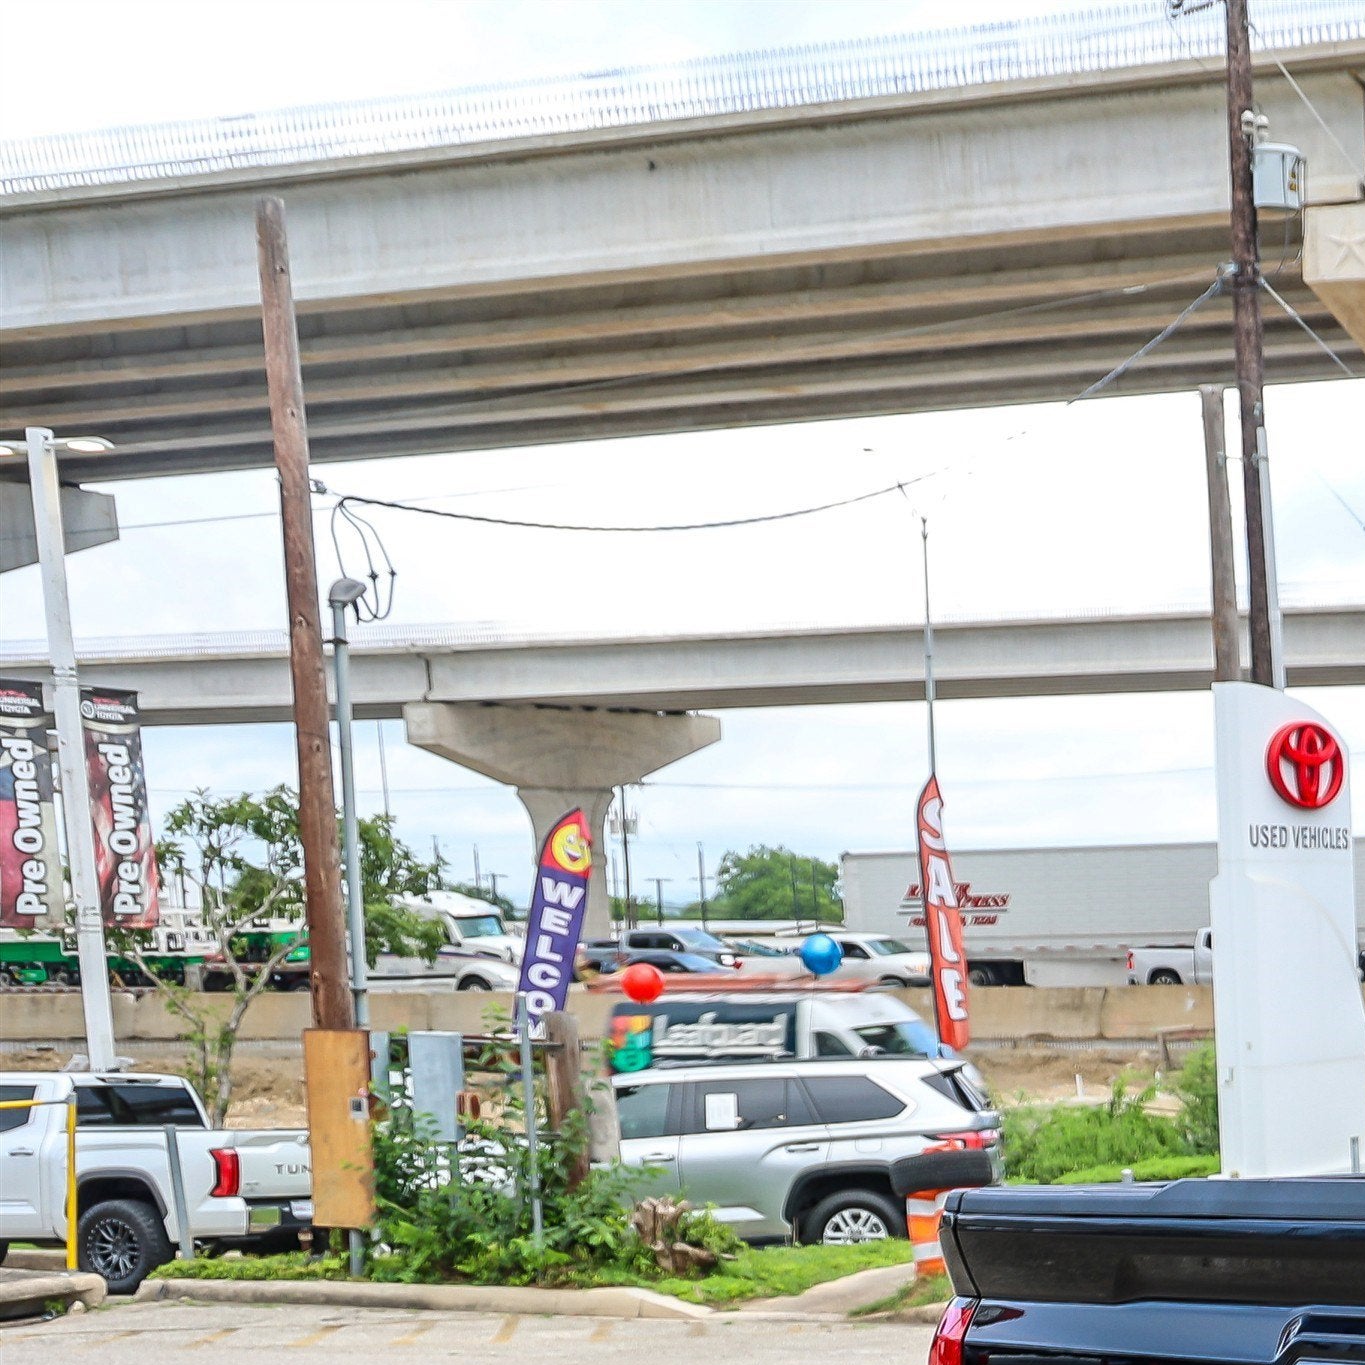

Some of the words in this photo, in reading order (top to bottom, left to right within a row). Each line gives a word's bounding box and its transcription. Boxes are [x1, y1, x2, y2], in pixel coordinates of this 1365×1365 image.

[2, 737, 43, 854] Owned
[98, 743, 139, 855] Owned
[1249, 824, 1288, 848] USED
[1292, 825, 1348, 849] VEHICLES
[15, 859, 48, 916] Pre
[113, 860, 144, 916] Pre
[921, 796, 968, 1020] SALE
[526, 876, 585, 1040] WELCOM
[274, 1163, 312, 1175] TUN
